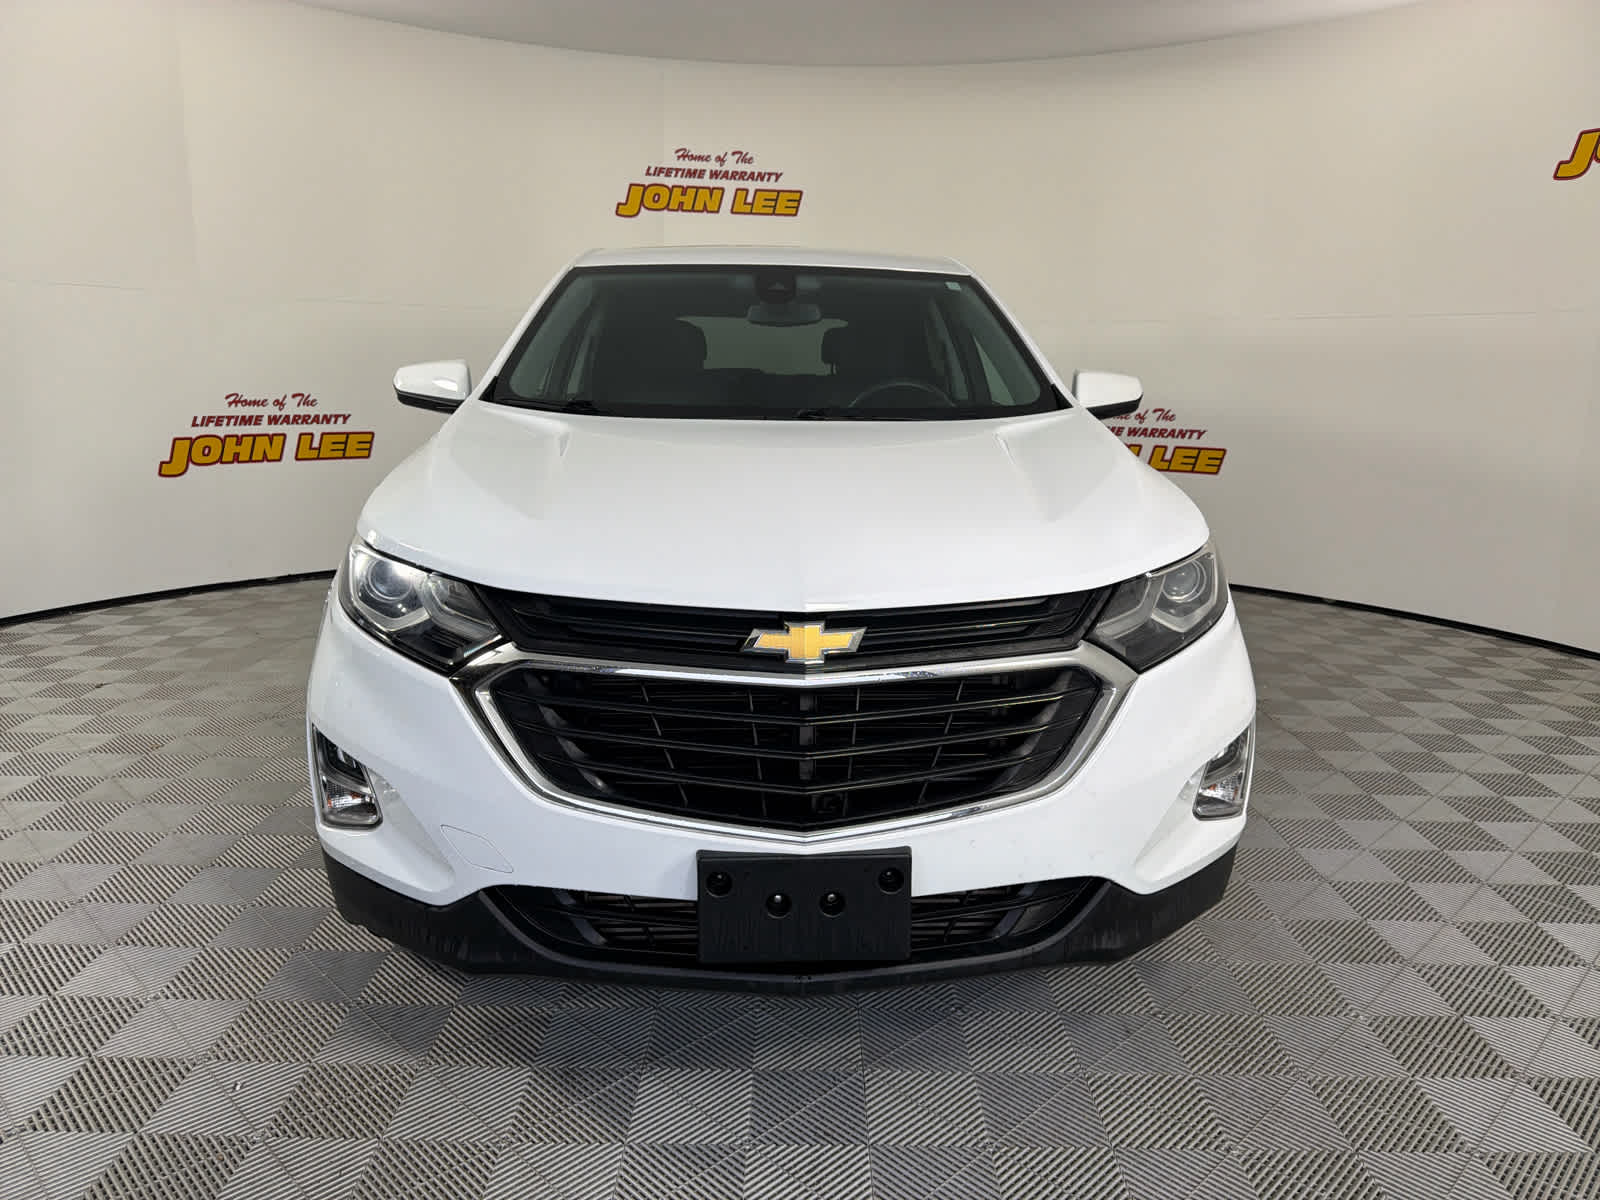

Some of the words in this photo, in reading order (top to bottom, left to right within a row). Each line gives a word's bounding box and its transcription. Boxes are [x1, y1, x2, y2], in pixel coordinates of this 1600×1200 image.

[674, 148, 711, 162] Home
[715, 152, 728, 167] of
[731, 151, 753, 164] The
[645, 166, 706, 180] LIFETIME
[708, 169, 783, 183] WARRANTY
[616, 184, 724, 218] JOHN
[731, 188, 803, 217] LEE
[224, 393, 268, 408] Home
[272, 394, 287, 411] of
[291, 393, 318, 408] The
[191, 415, 265, 428] LIFETIME
[267, 414, 351, 426] WARRANTY
[1134, 409, 1149, 424] of
[1152, 408, 1176, 422] The
[1127, 426, 1208, 440] WARRANTY
[158, 433, 287, 478] JOHN
[295, 432, 375, 461] LEE
[1147, 445, 1226, 475] LEE
